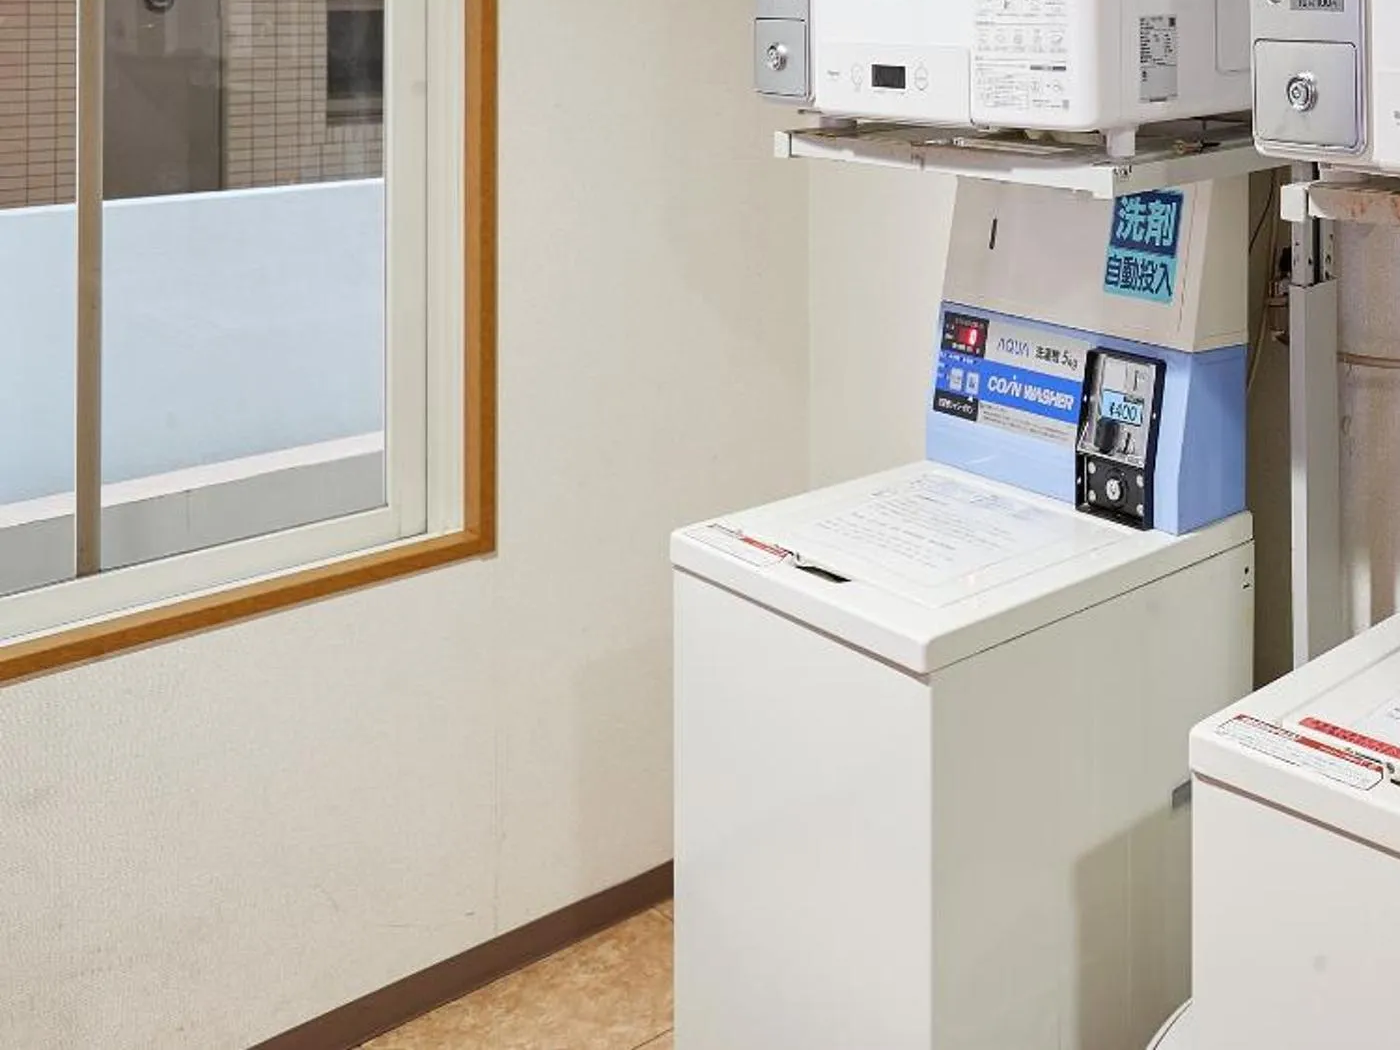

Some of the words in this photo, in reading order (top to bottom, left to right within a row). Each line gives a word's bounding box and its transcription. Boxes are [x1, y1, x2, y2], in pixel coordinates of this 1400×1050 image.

[1116, 196, 1177, 246] 洗剤
[1105, 253, 1173, 296] 自動投入
[1023, 384, 1075, 411] WASHER
